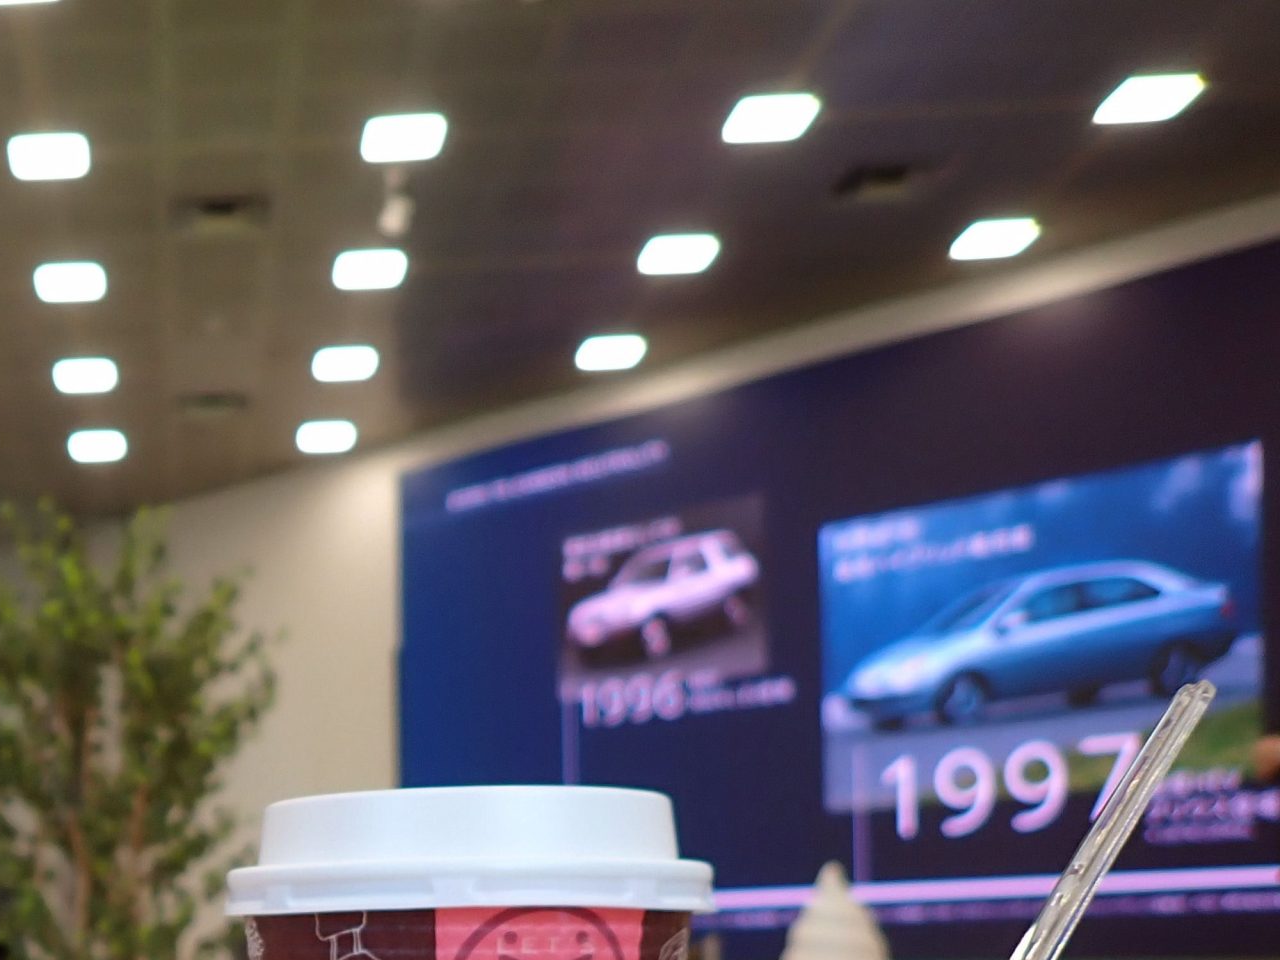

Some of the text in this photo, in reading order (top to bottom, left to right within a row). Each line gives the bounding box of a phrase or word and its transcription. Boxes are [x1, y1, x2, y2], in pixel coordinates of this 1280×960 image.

[581, 670, 685, 727] 1996
[879, 732, 1142, 841] 1997
[497, 936, 596, 954] LETS
